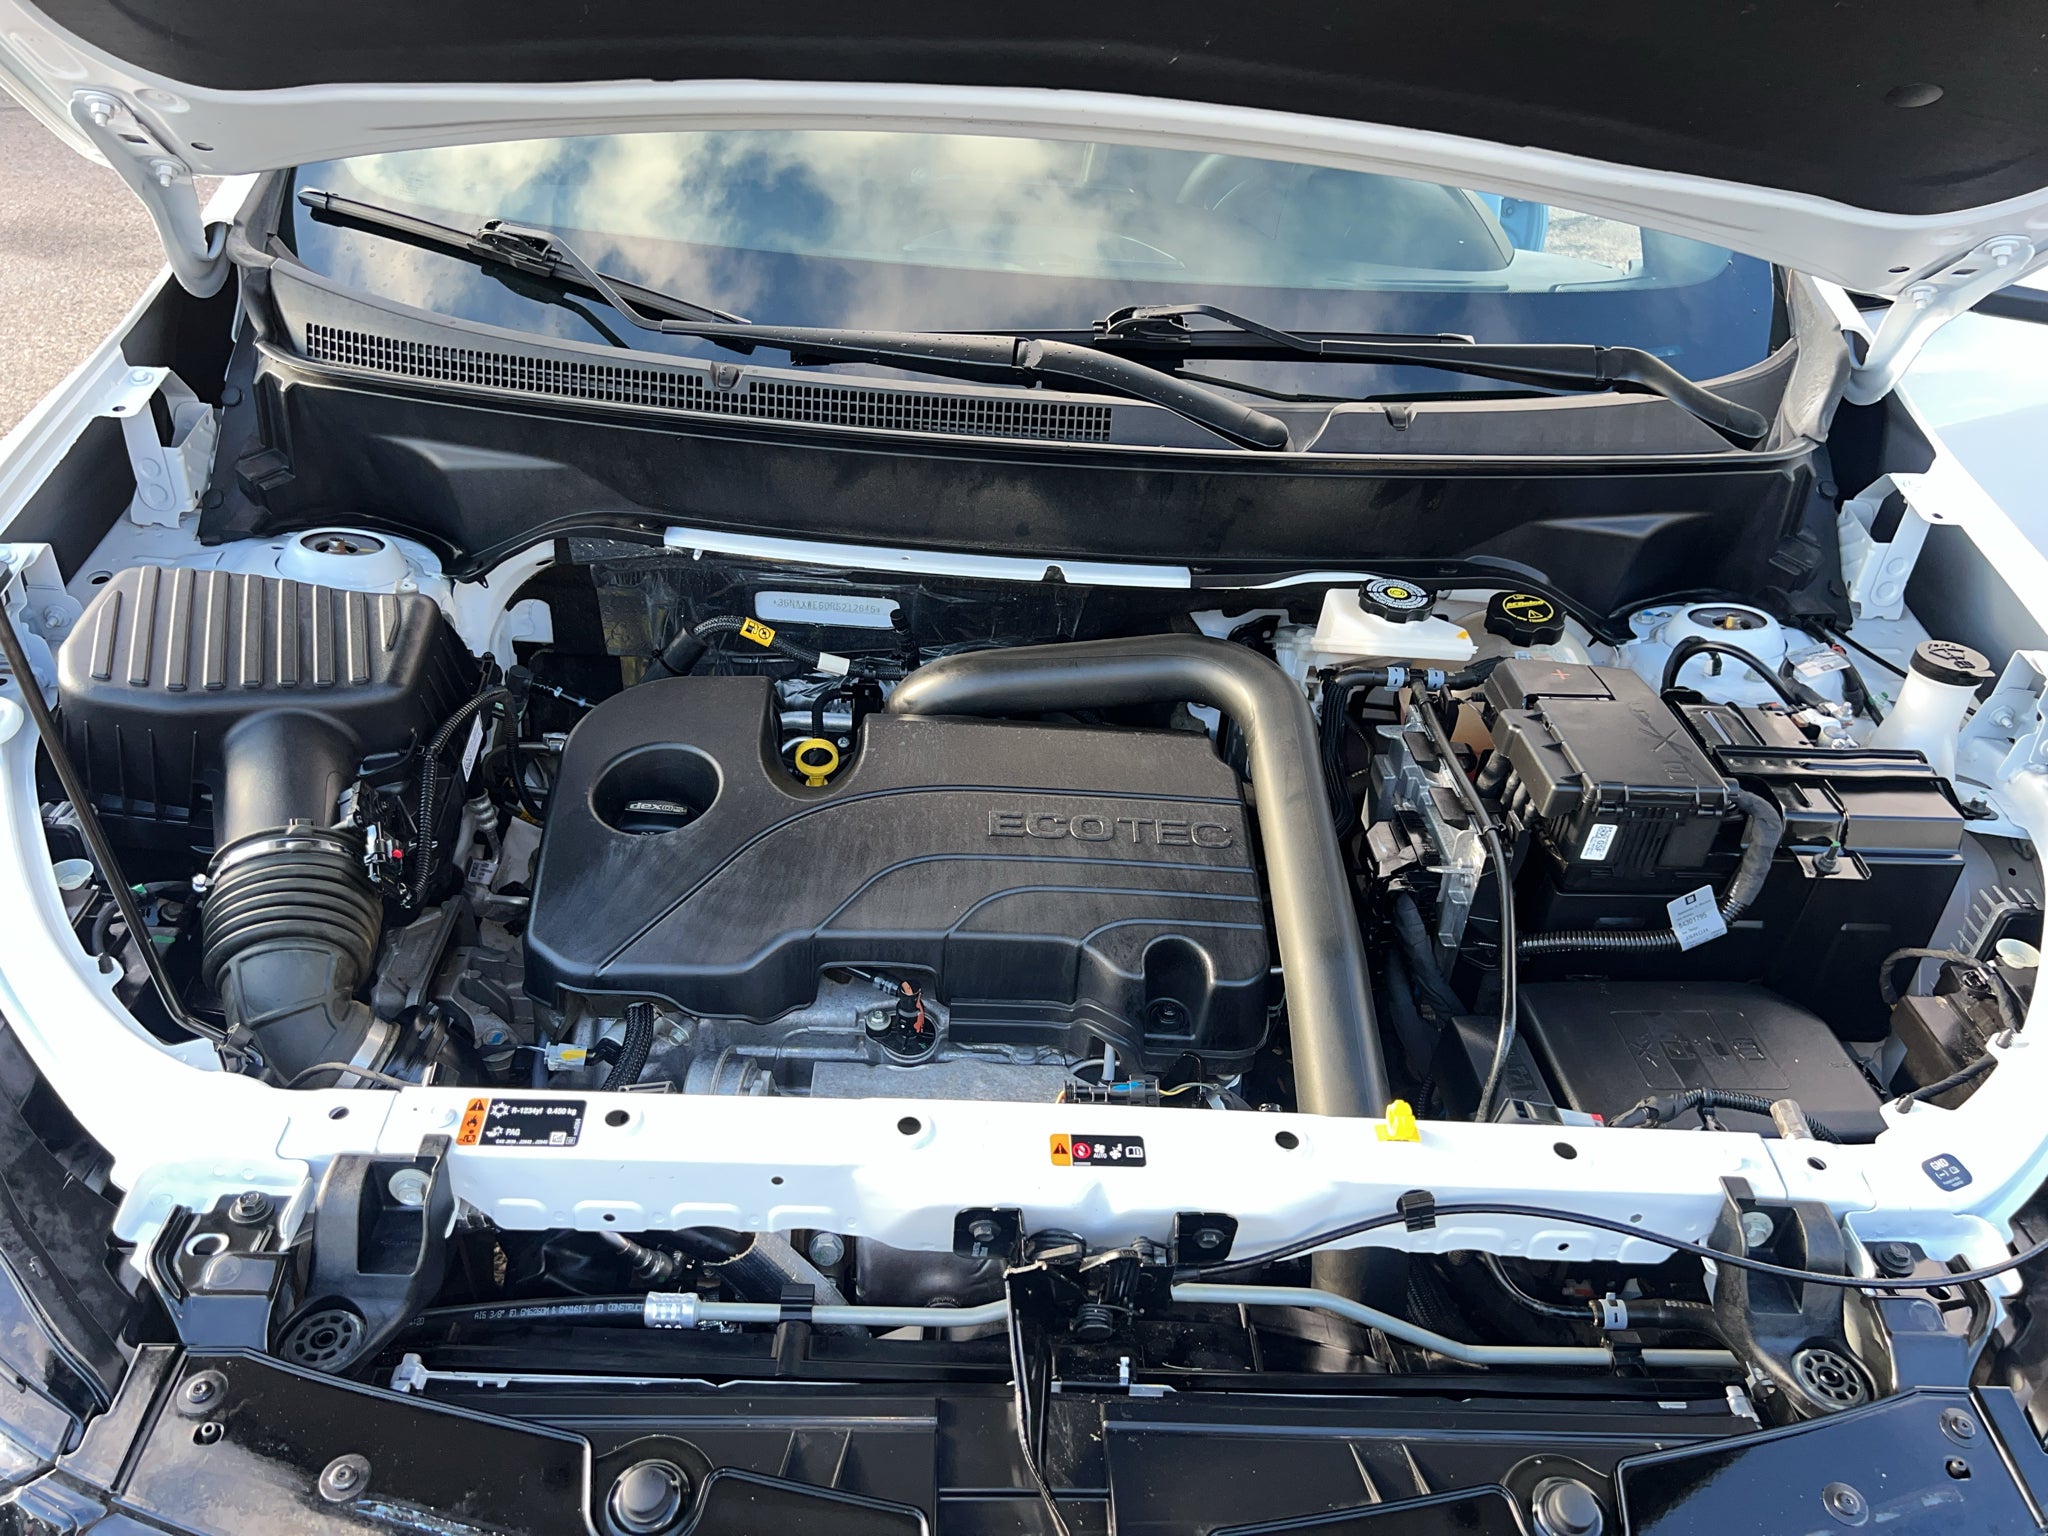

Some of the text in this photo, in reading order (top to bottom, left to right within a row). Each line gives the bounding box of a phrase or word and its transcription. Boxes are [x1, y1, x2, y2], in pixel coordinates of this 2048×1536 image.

[988, 810, 1233, 849] ECOTEC
[511, 1106, 544, 1116] R-1234yf
[567, 1107, 577, 1116] kg
[505, 1128, 521, 1136] PAG
[1929, 1157, 1949, 1171] GND
